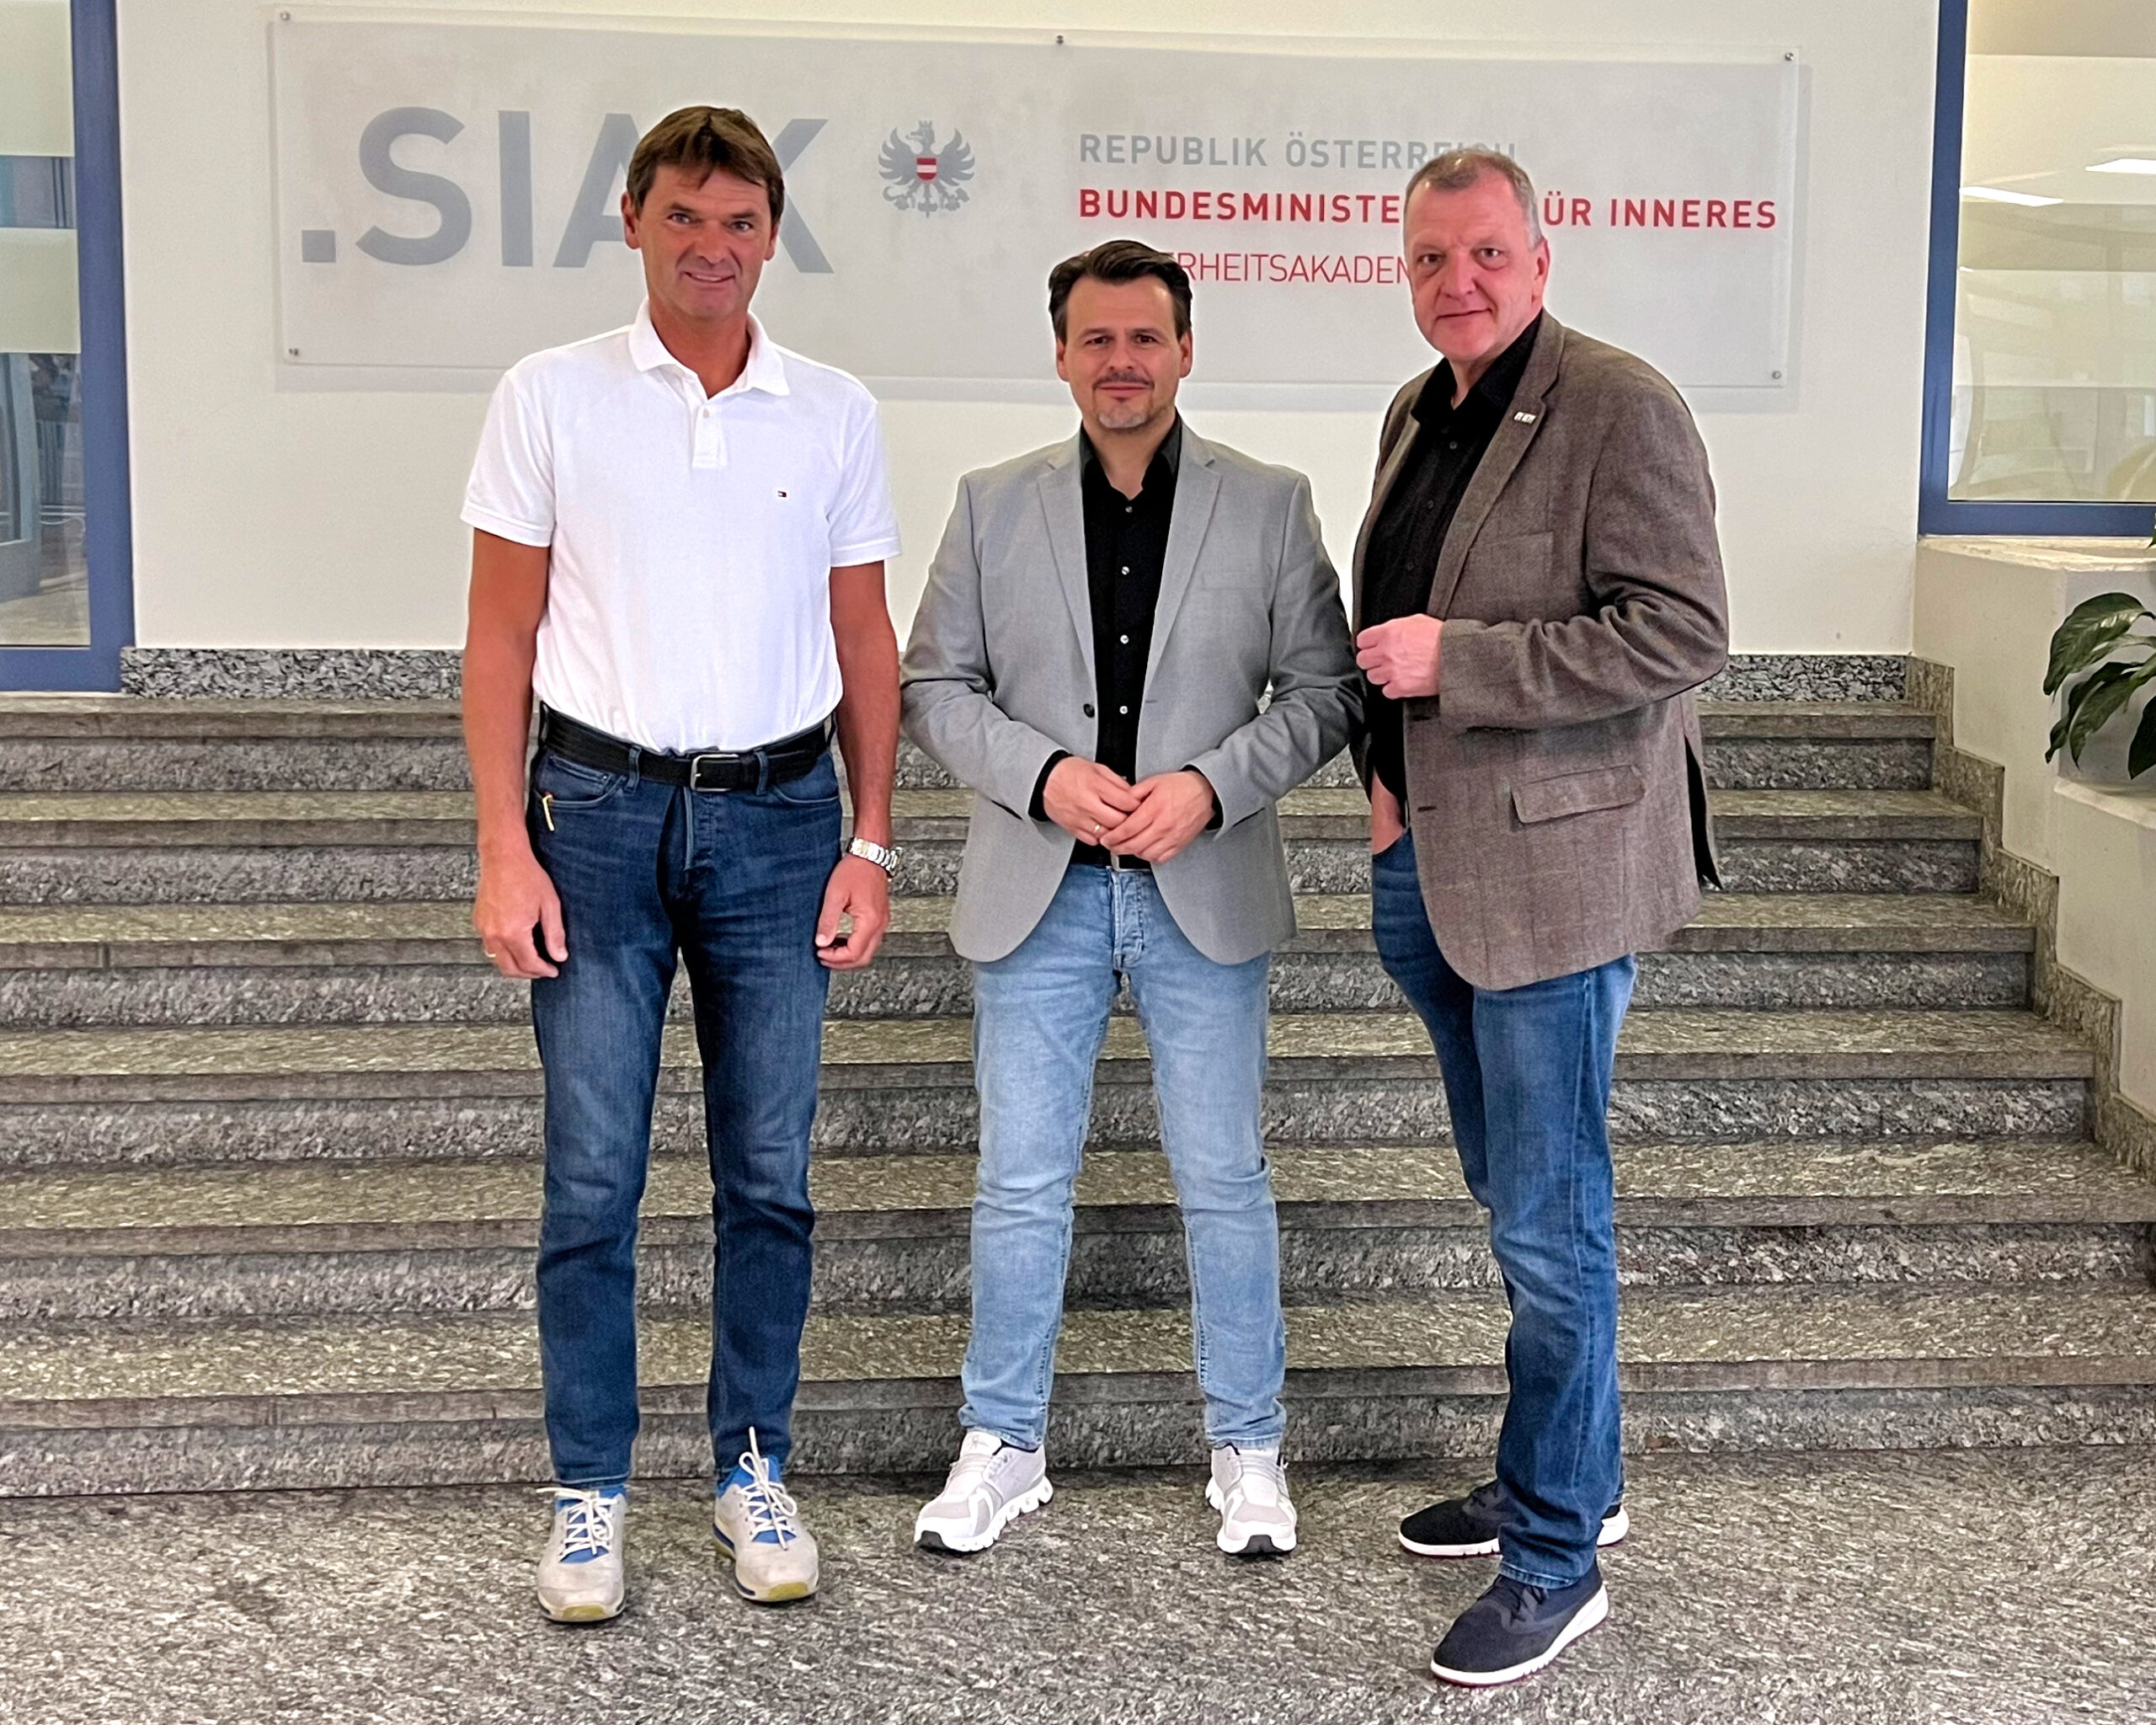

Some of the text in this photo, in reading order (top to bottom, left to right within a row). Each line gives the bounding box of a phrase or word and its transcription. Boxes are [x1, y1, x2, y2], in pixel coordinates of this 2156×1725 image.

[1080, 133, 1267, 168] REPUBLIK
[1079, 189, 1776, 228] BUNDESMINISTE ÜR INNERES
